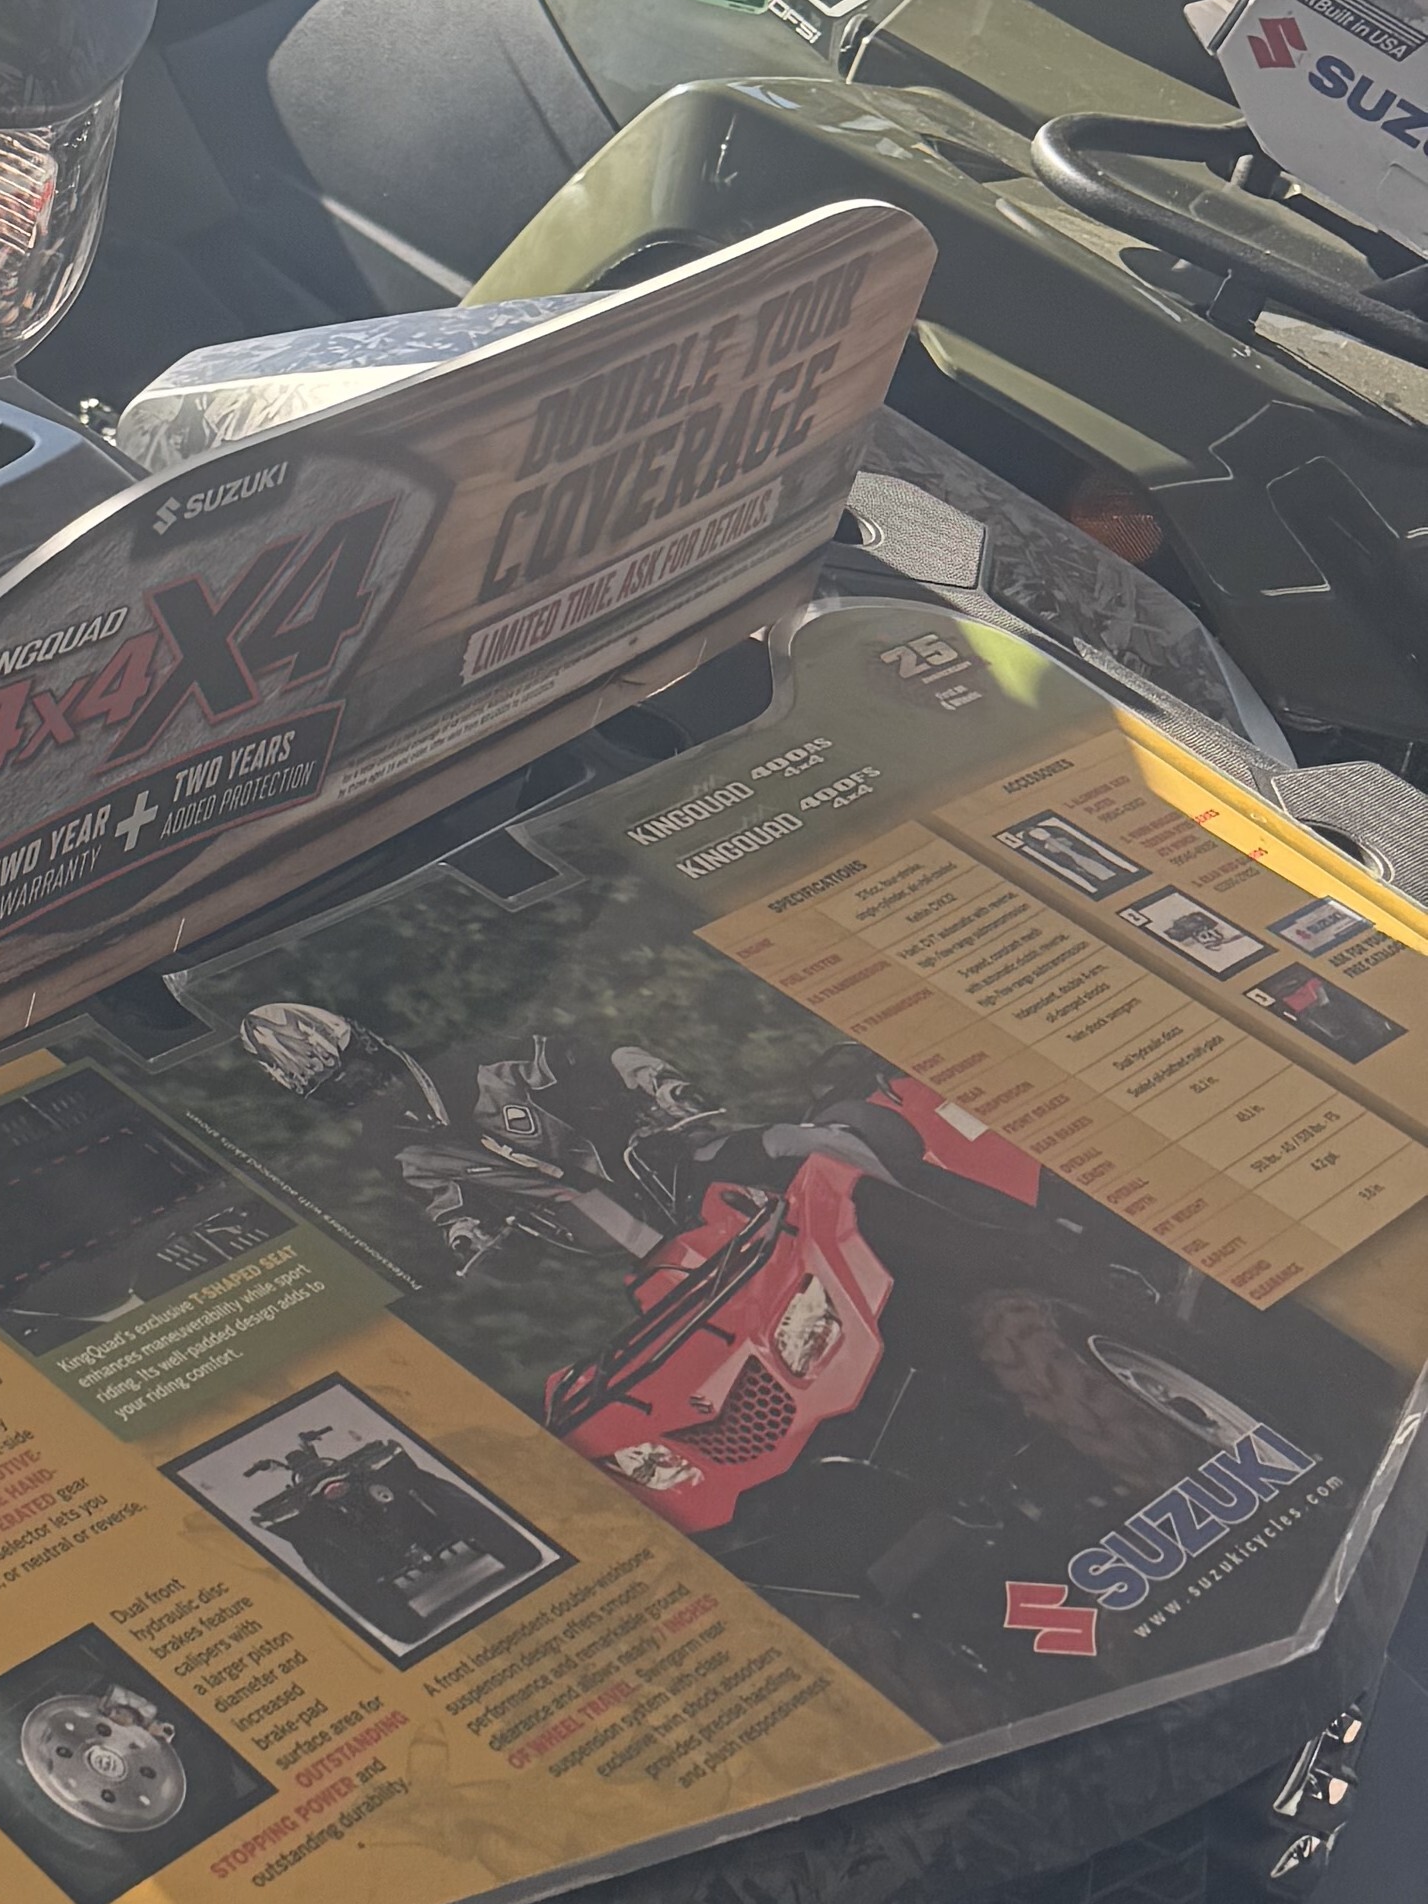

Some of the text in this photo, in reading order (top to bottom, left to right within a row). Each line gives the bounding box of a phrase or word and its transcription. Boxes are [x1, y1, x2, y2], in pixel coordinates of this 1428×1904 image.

[1352, 18, 1368, 36] in
[1368, 27, 1410, 60] USA
[1308, 54, 1428, 158] SUZ
[512, 247, 875, 488] DOUBLE YOUR
[184, 460, 289, 520] SUZUKI
[471, 341, 843, 611] COVERAGE
[469, 487, 778, 678] LIMITED TIME. ASK FOR DETAILS.
[880, 634, 959, 679] 25
[159, 758, 317, 841] ADDED PROTECTION
[167, 751, 225, 809] TWO
[224, 729, 298, 784] YEARS
[626, 737, 833, 847] KINGQUAD 400AS
[783, 754, 825, 778] 4x4
[832, 783, 874, 809] 4x4
[1002, 757, 1075, 794] ACCESSORIES
[44, 800, 113, 865] YEAR
[676, 765, 882, 880] KINGQUAD 400FS
[767, 859, 868, 915] SPECIFICATIONS
[53, 1244, 303, 1374] KingQuad's exclusive T-SHAPED SEAT
[72, 1262, 317, 1388] enhances maneuverability while sport
[90, 1278, 329, 1406] riding. Its well-padded design adds to
[110, 1345, 247, 1422] your riding comfort.
[1068, 1422, 1316, 1611] SUZUKI
[1133, 1474, 1344, 1638] www.suzukicycles.com
